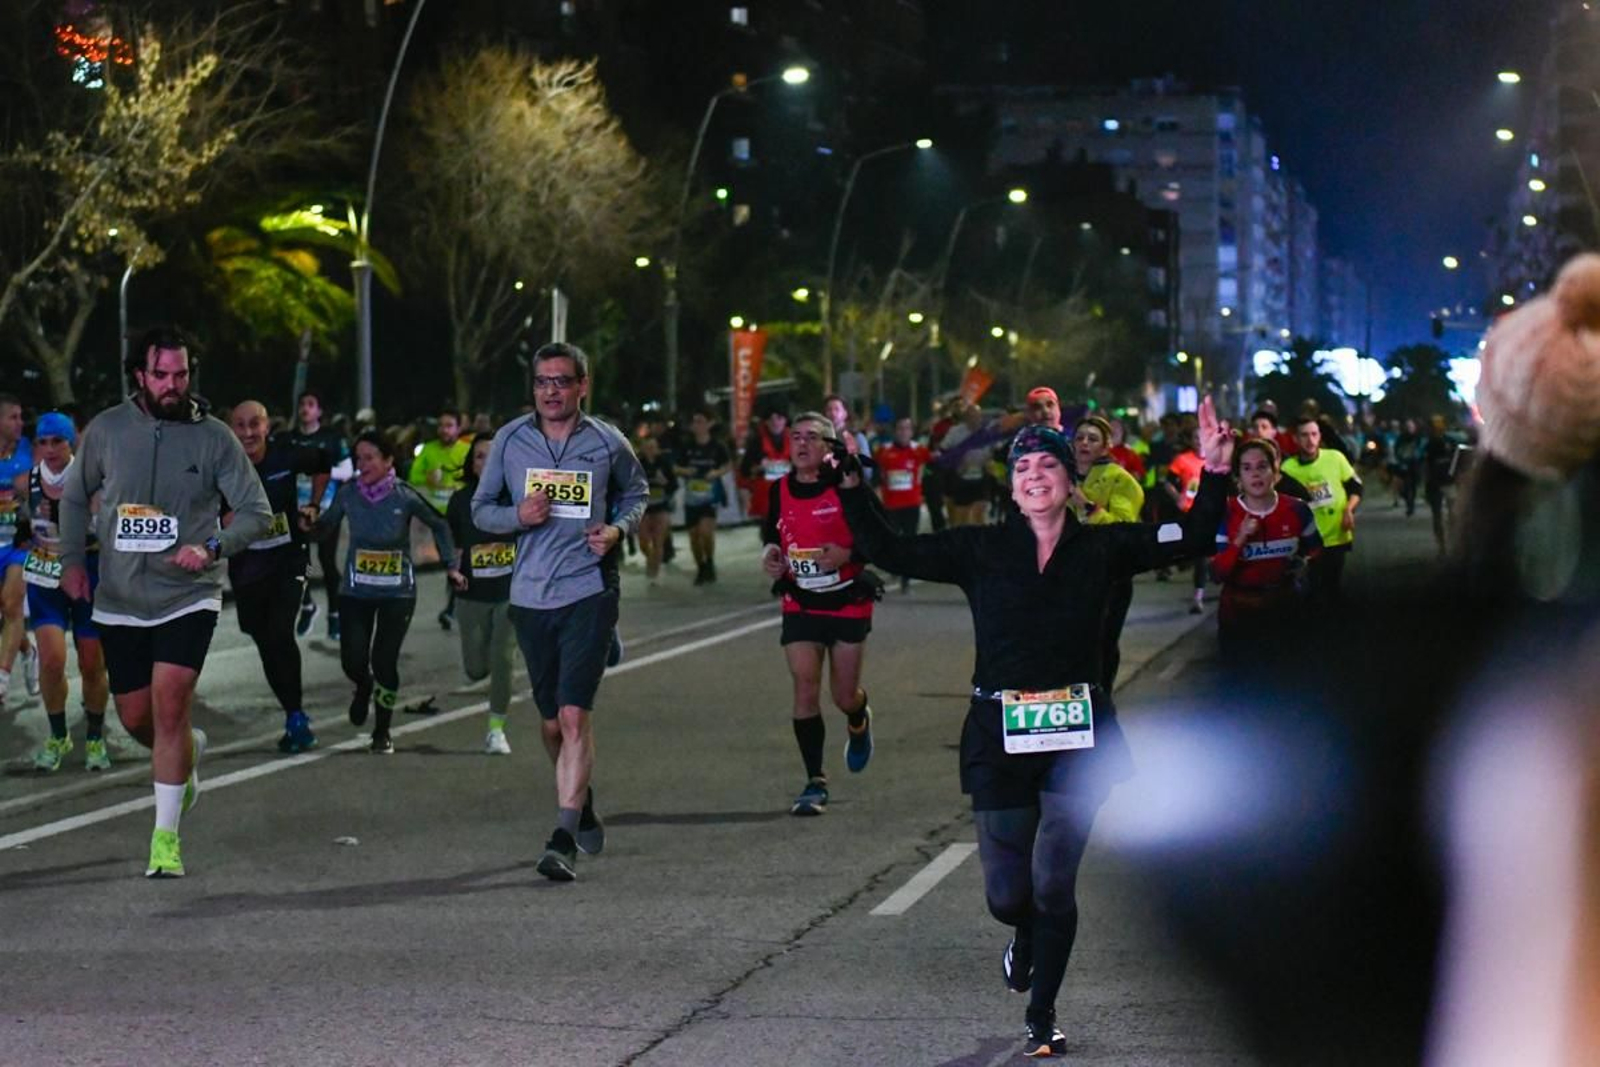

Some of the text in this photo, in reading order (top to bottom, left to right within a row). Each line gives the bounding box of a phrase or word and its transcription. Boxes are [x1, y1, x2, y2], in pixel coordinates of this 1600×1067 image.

[121, 517, 172, 535] 8598
[792, 559, 822, 574] 961
[1011, 701, 1085, 729] 1768
